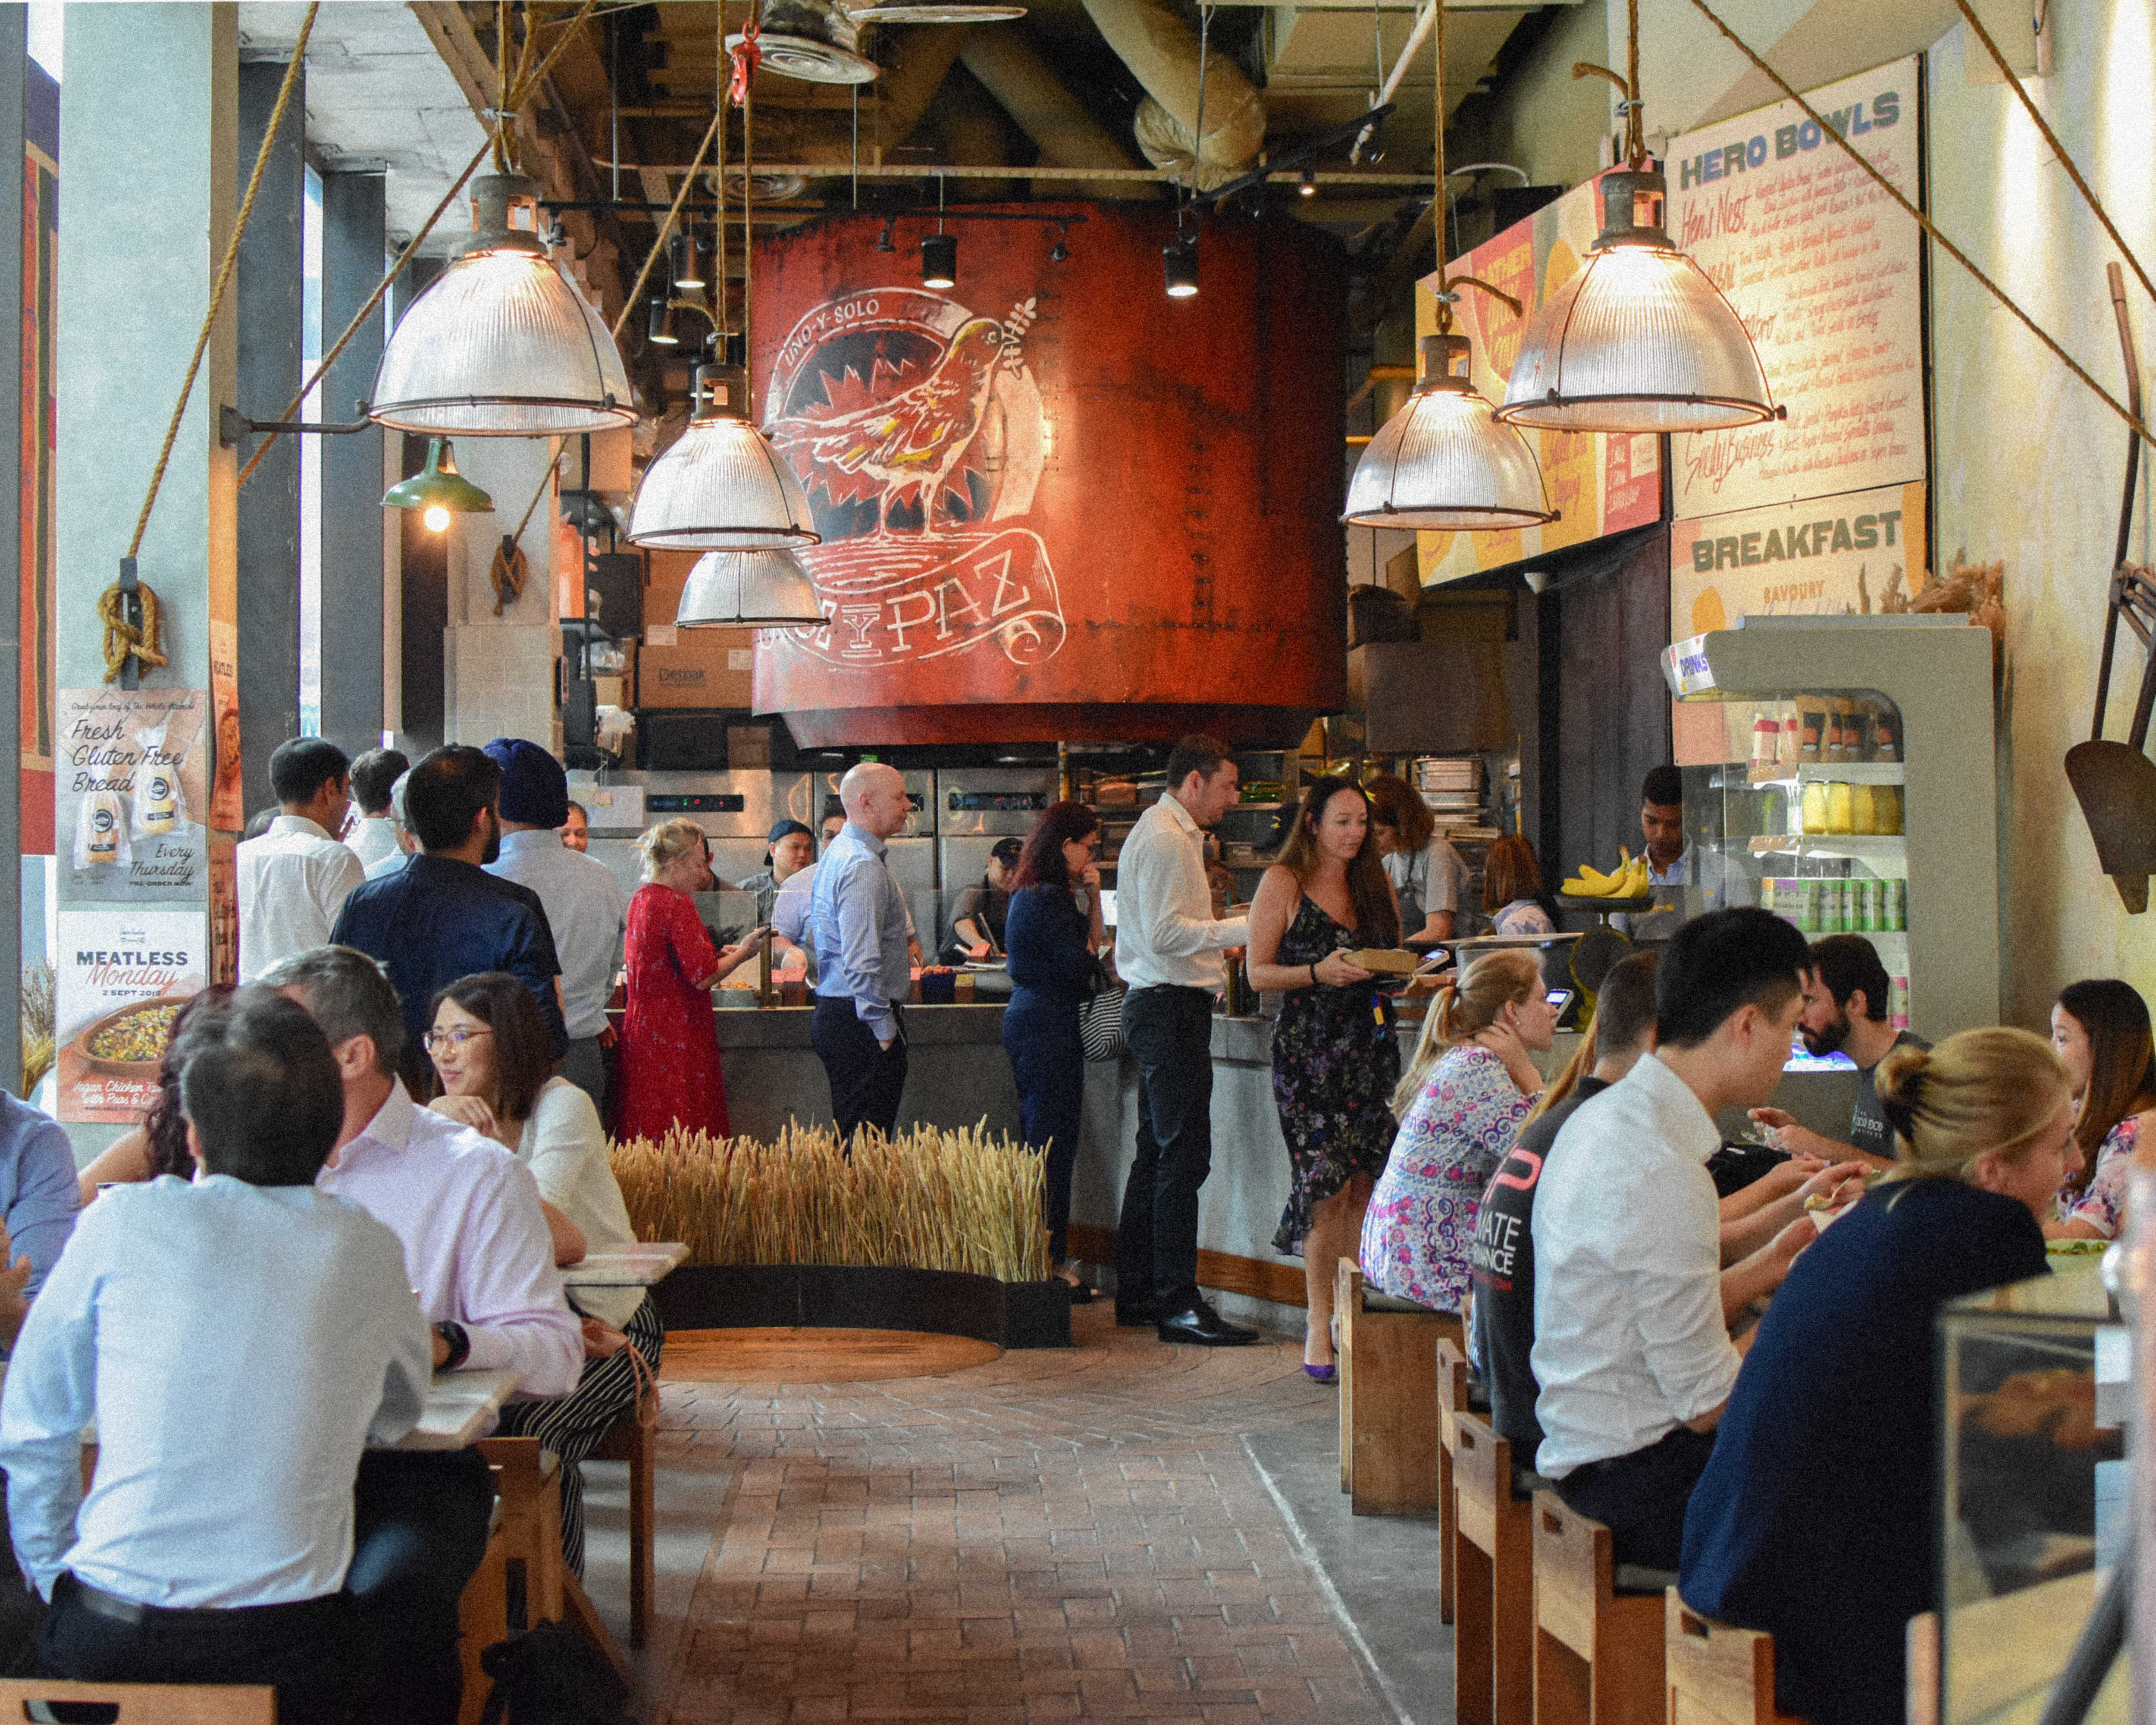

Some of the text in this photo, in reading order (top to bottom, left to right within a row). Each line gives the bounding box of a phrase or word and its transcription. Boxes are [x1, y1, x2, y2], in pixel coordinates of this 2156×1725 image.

[1681, 135, 1767, 191] HERO
[1775, 91, 1899, 161] BOWLS
[1715, 183, 1752, 239] Nest
[1691, 510, 1901, 573] BREAKFAST
[887, 550, 1031, 653] PAZ
[1764, 580, 1824, 604] SAVOURY
[1680, 652, 1708, 677] DRINKS
[72, 719, 125, 740] Fresh
[72, 745, 184, 766] Gluten Free
[72, 772, 135, 792] Bread
[156, 844, 194, 862] Every
[130, 861, 194, 882] Thursday
[76, 951, 188, 966] MEATLESS
[85, 961, 177, 995] Monday
[74, 1081, 103, 1094] Vegan
[105, 1080, 144, 1093] Chicken
[107, 1093, 129, 1104] Peas
[131, 1093, 139, 1104] &
